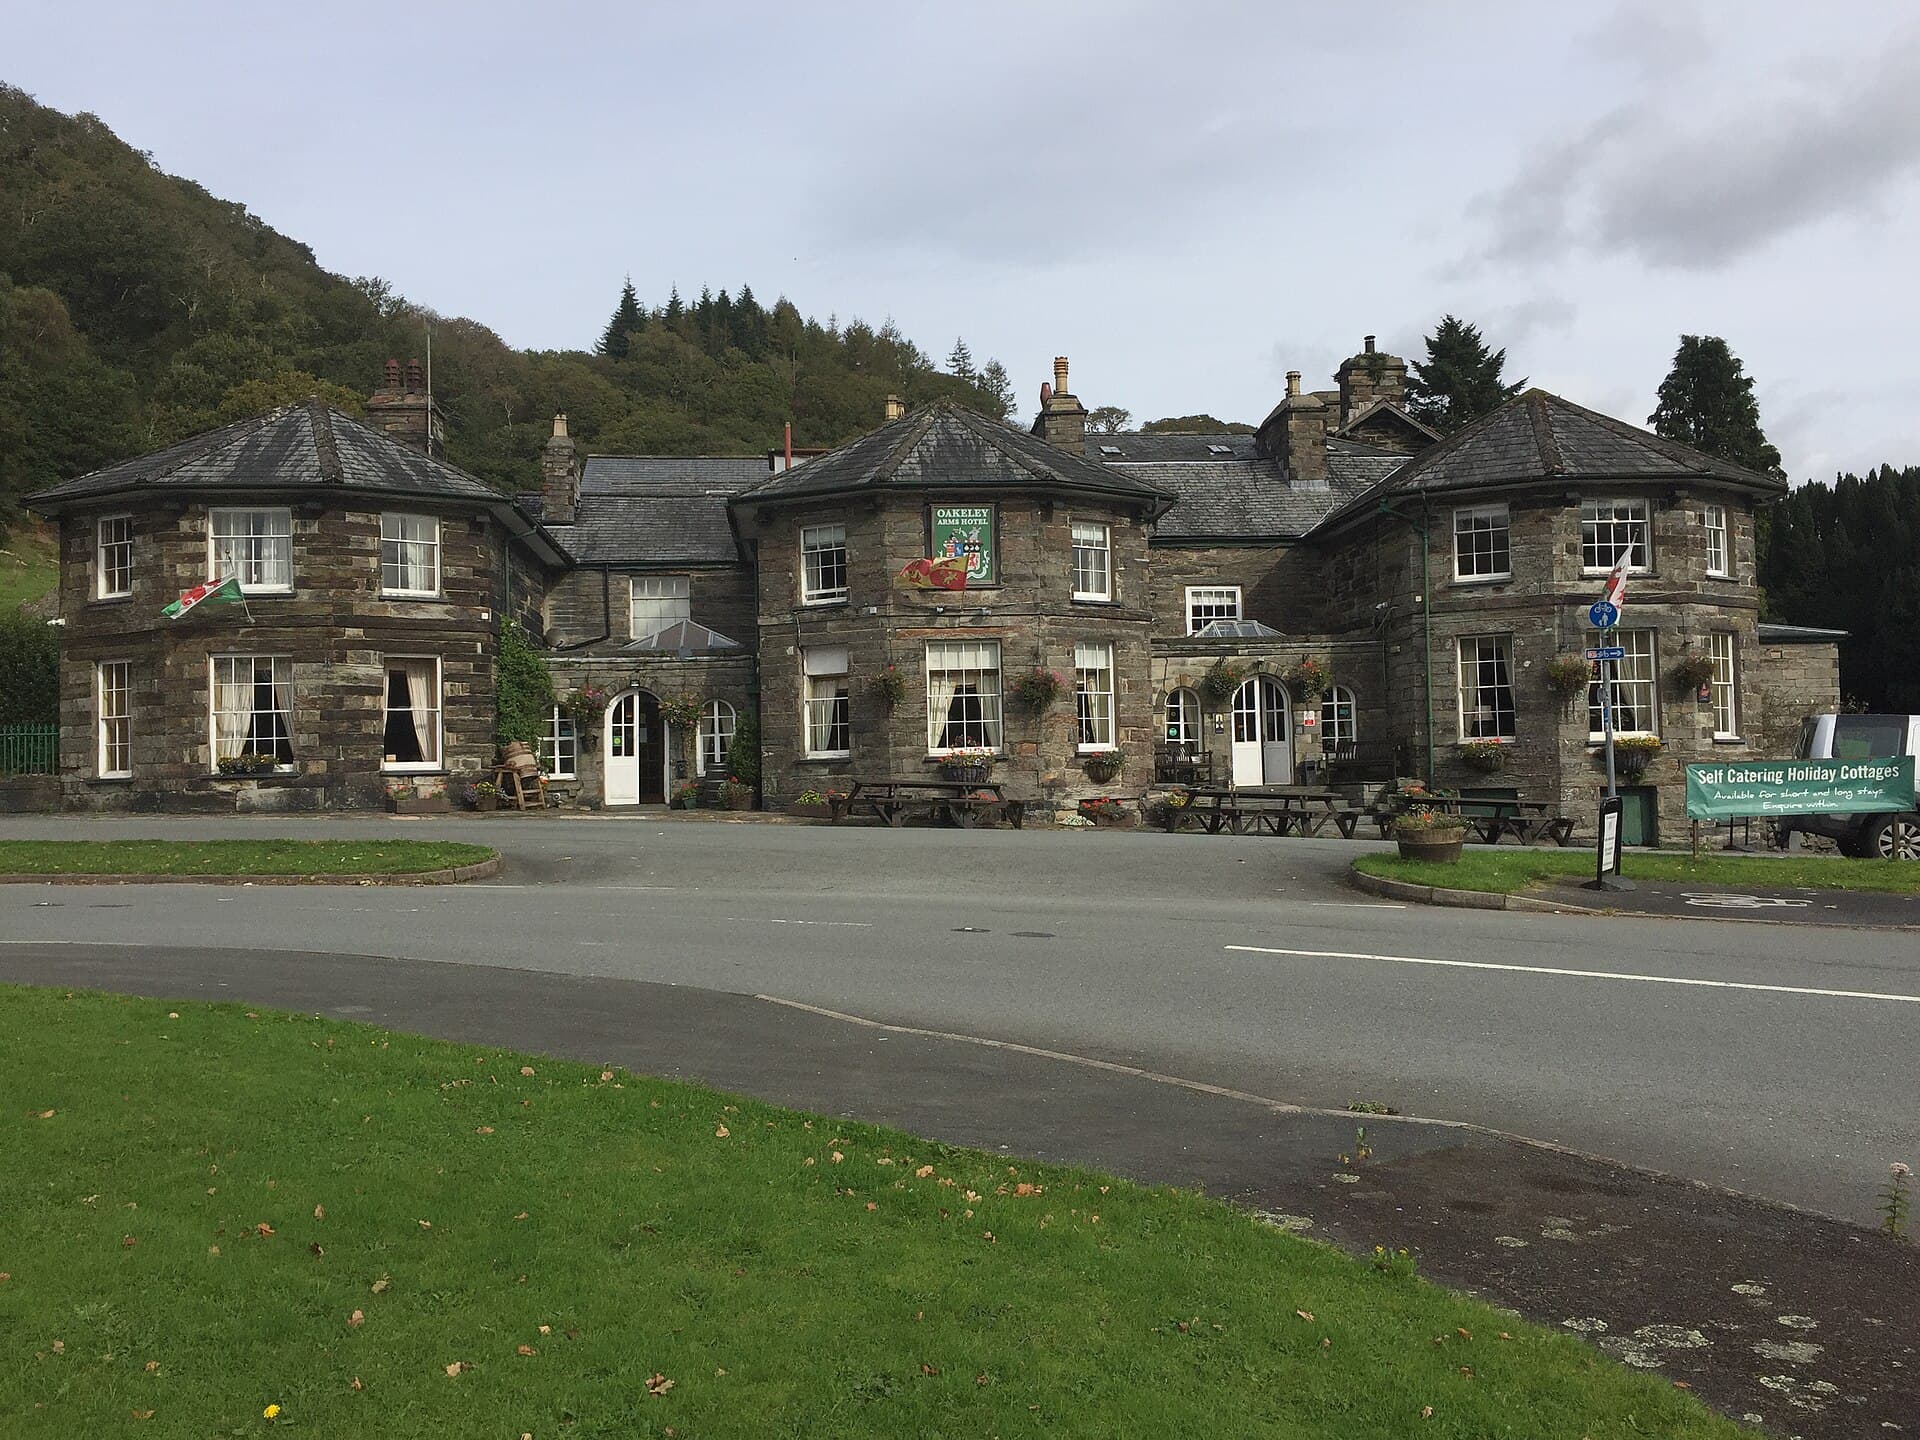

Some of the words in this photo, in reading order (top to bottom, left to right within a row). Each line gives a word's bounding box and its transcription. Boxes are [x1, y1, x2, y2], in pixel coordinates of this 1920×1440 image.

[937, 509, 989, 517] OAKELEY
[1698, 769, 1723, 784] Self
[1728, 769, 1784, 785] Catering
[1788, 767, 1836, 783] Holiday
[1840, 765, 1899, 780] Cottages
[1714, 790, 1755, 799] Available
[1759, 790, 1777, 799] for
[1781, 788, 1809, 798] short
[1813, 787, 1830, 796] and
[1834, 787, 1853, 799] long
[1763, 801, 1803, 812] Enquire
